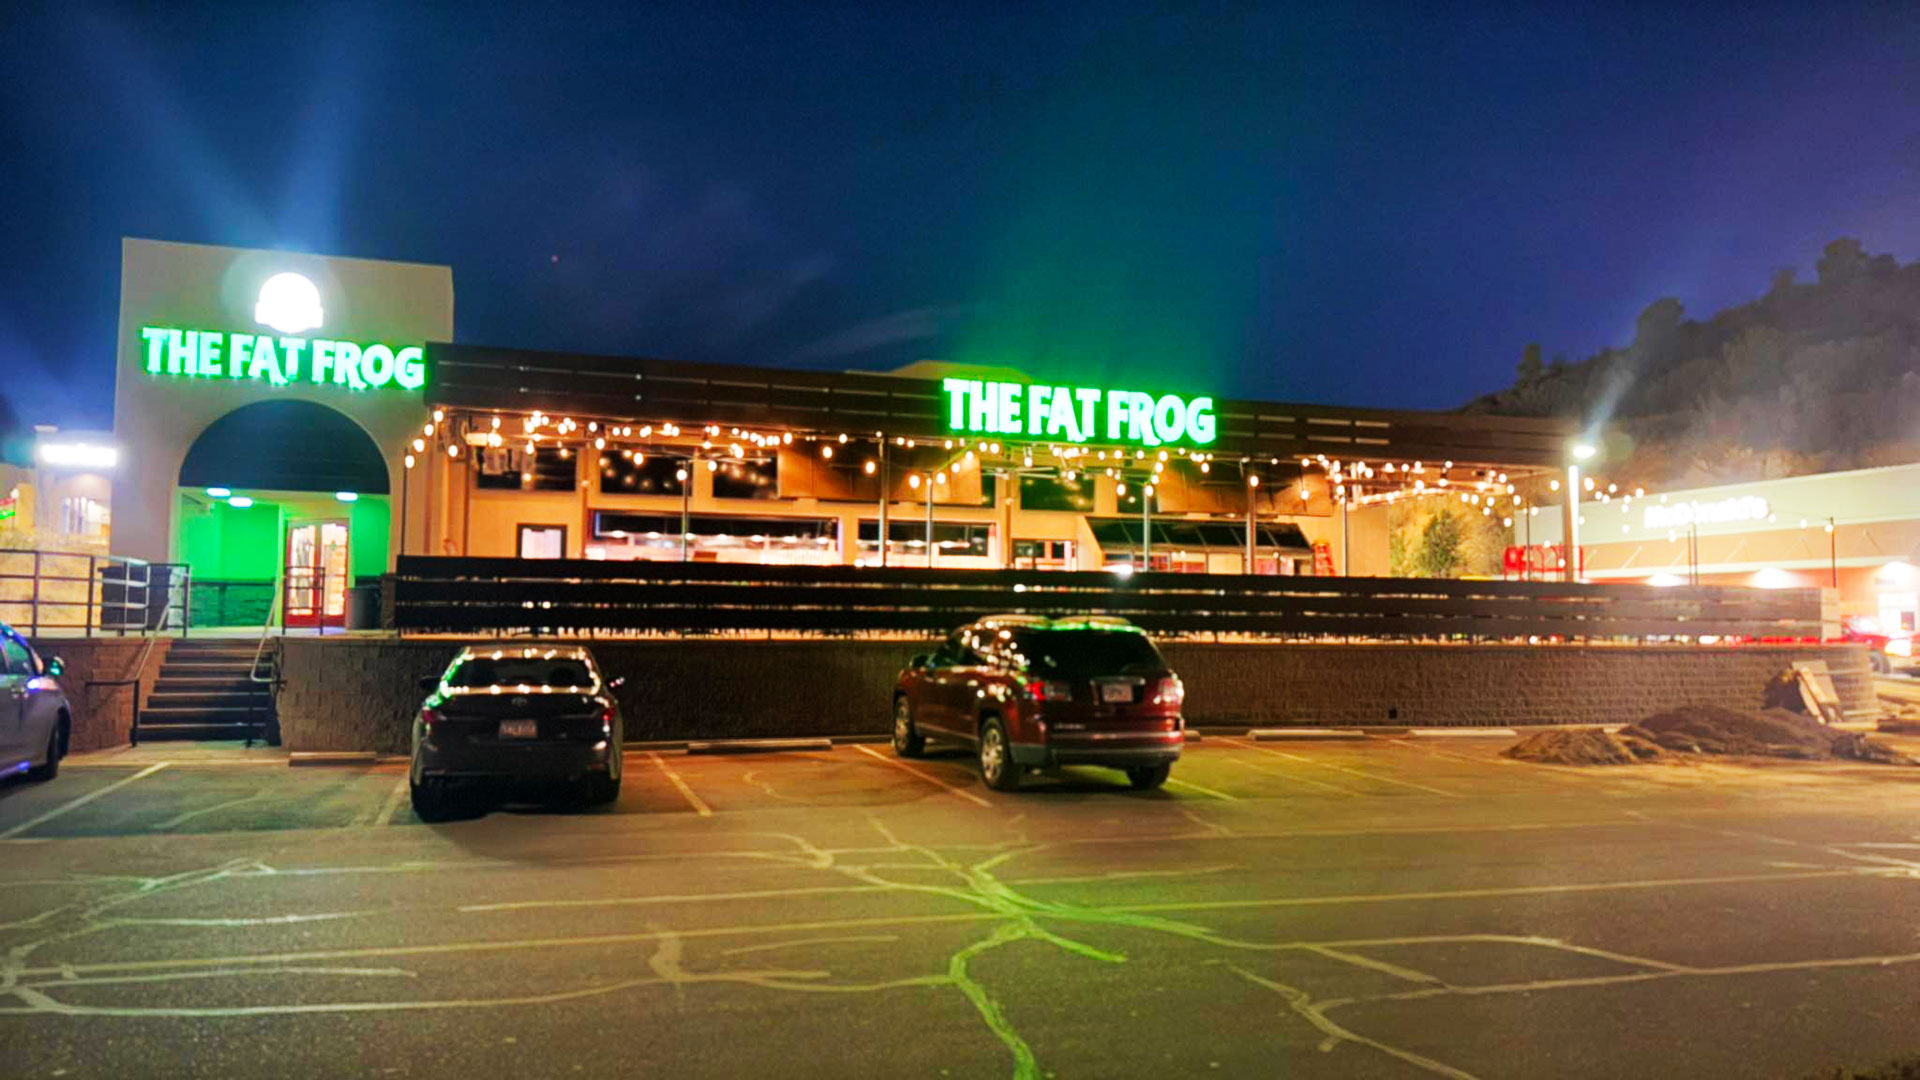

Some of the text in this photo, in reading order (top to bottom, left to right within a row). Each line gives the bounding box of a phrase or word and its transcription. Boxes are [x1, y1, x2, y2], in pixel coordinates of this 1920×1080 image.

[142, 327, 425, 390] THE FAT FROG
[943, 378, 1216, 446] THE FAT FROG
